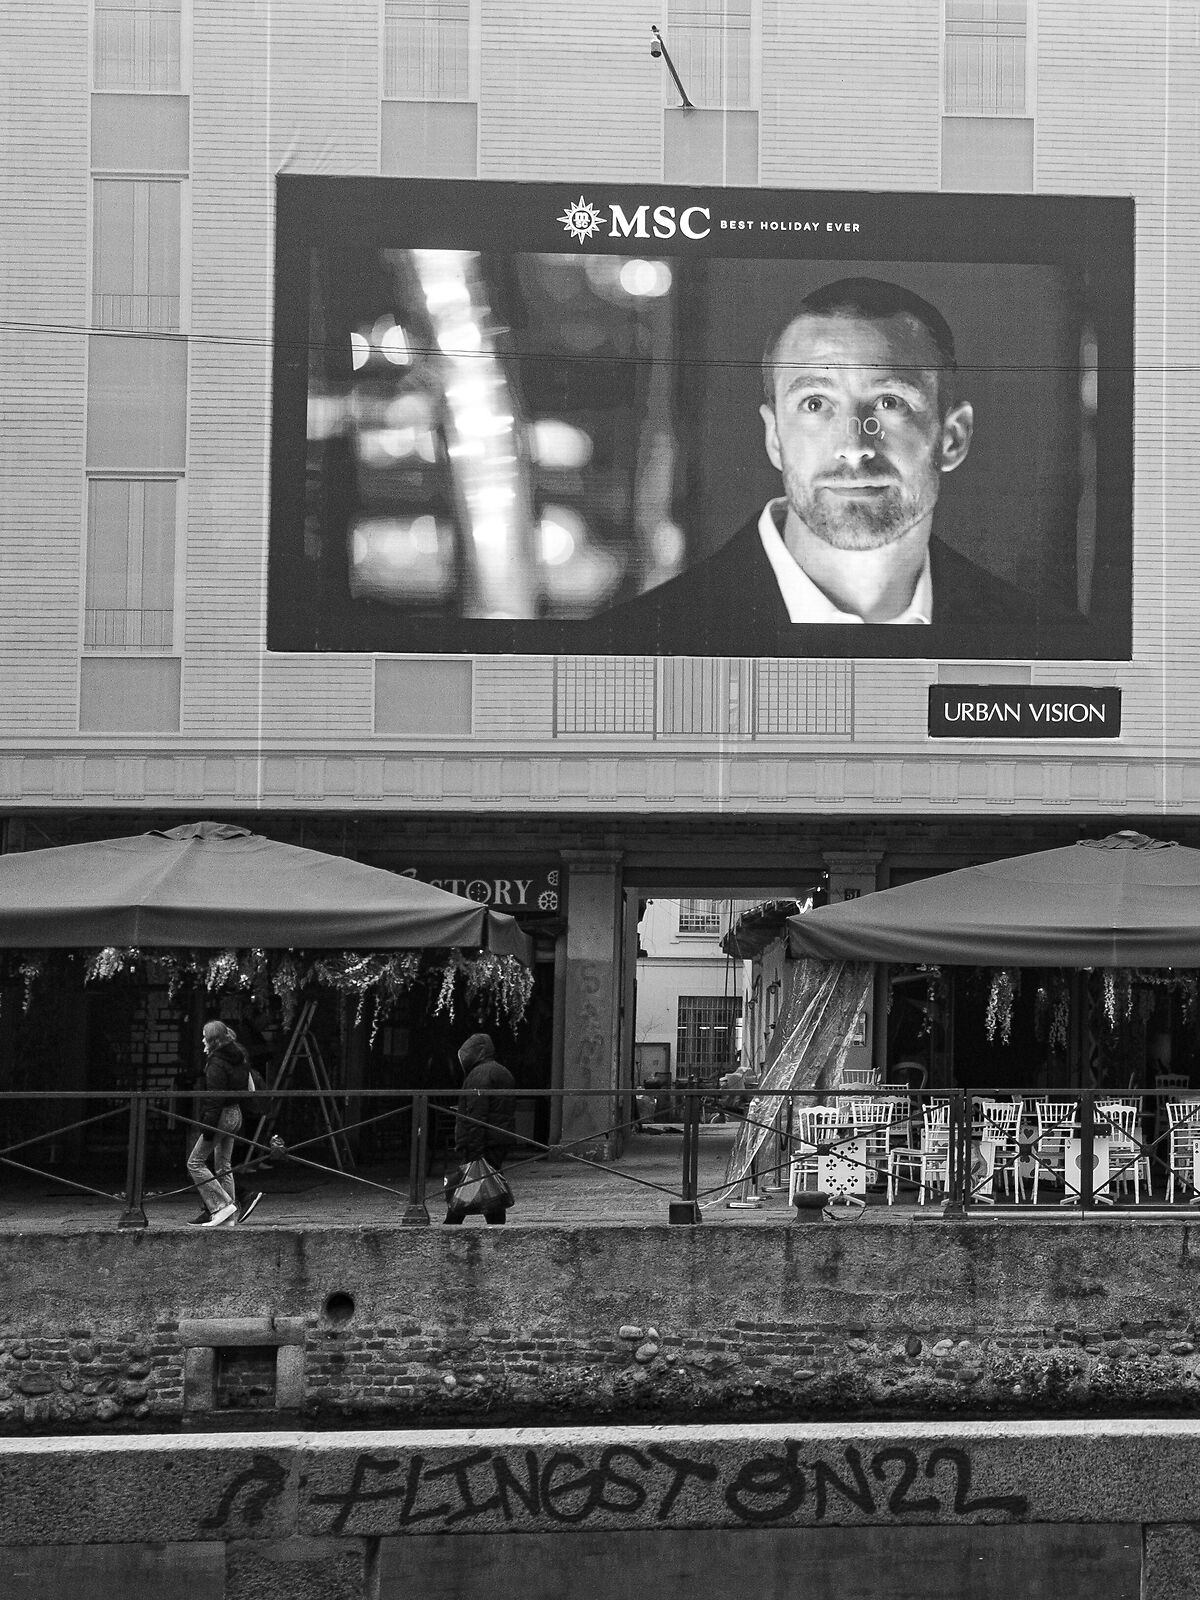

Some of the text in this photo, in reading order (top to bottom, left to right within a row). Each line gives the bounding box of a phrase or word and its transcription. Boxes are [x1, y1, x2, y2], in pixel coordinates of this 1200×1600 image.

[608, 204, 861, 240] MSC BEST HOLIDAY EVER
[944, 702, 1106, 723] URBAN VISION
